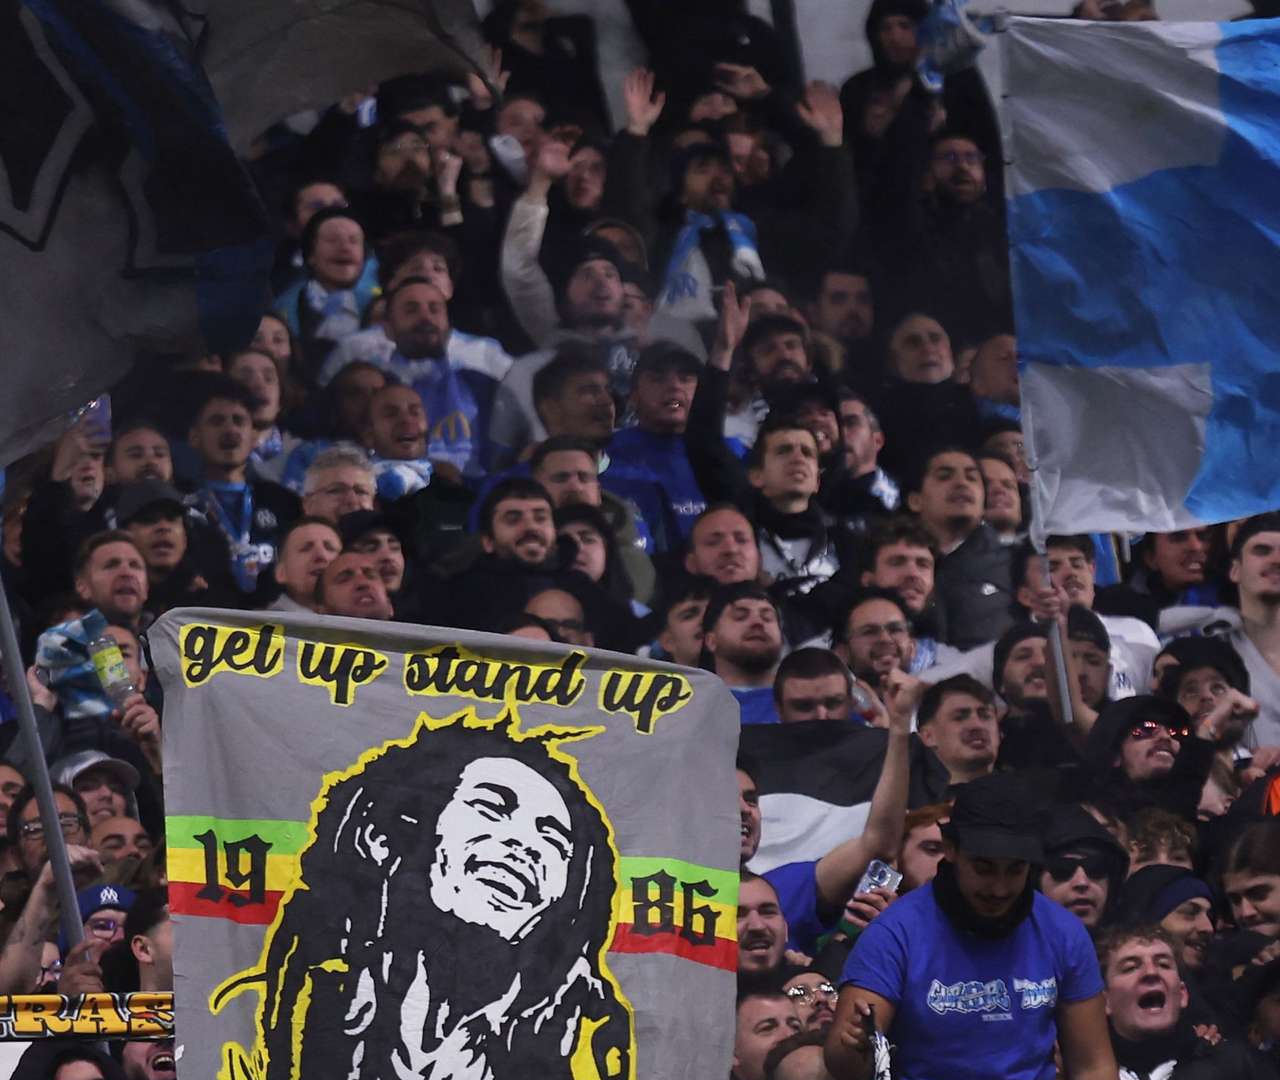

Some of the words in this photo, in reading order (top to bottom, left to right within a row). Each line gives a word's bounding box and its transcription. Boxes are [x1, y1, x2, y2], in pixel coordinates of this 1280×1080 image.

[300, 641, 386, 702] up
[405, 648, 585, 708] stand
[600, 668, 692, 732] up
[194, 830, 272, 906] 19
[632, 869, 719, 948] 86
